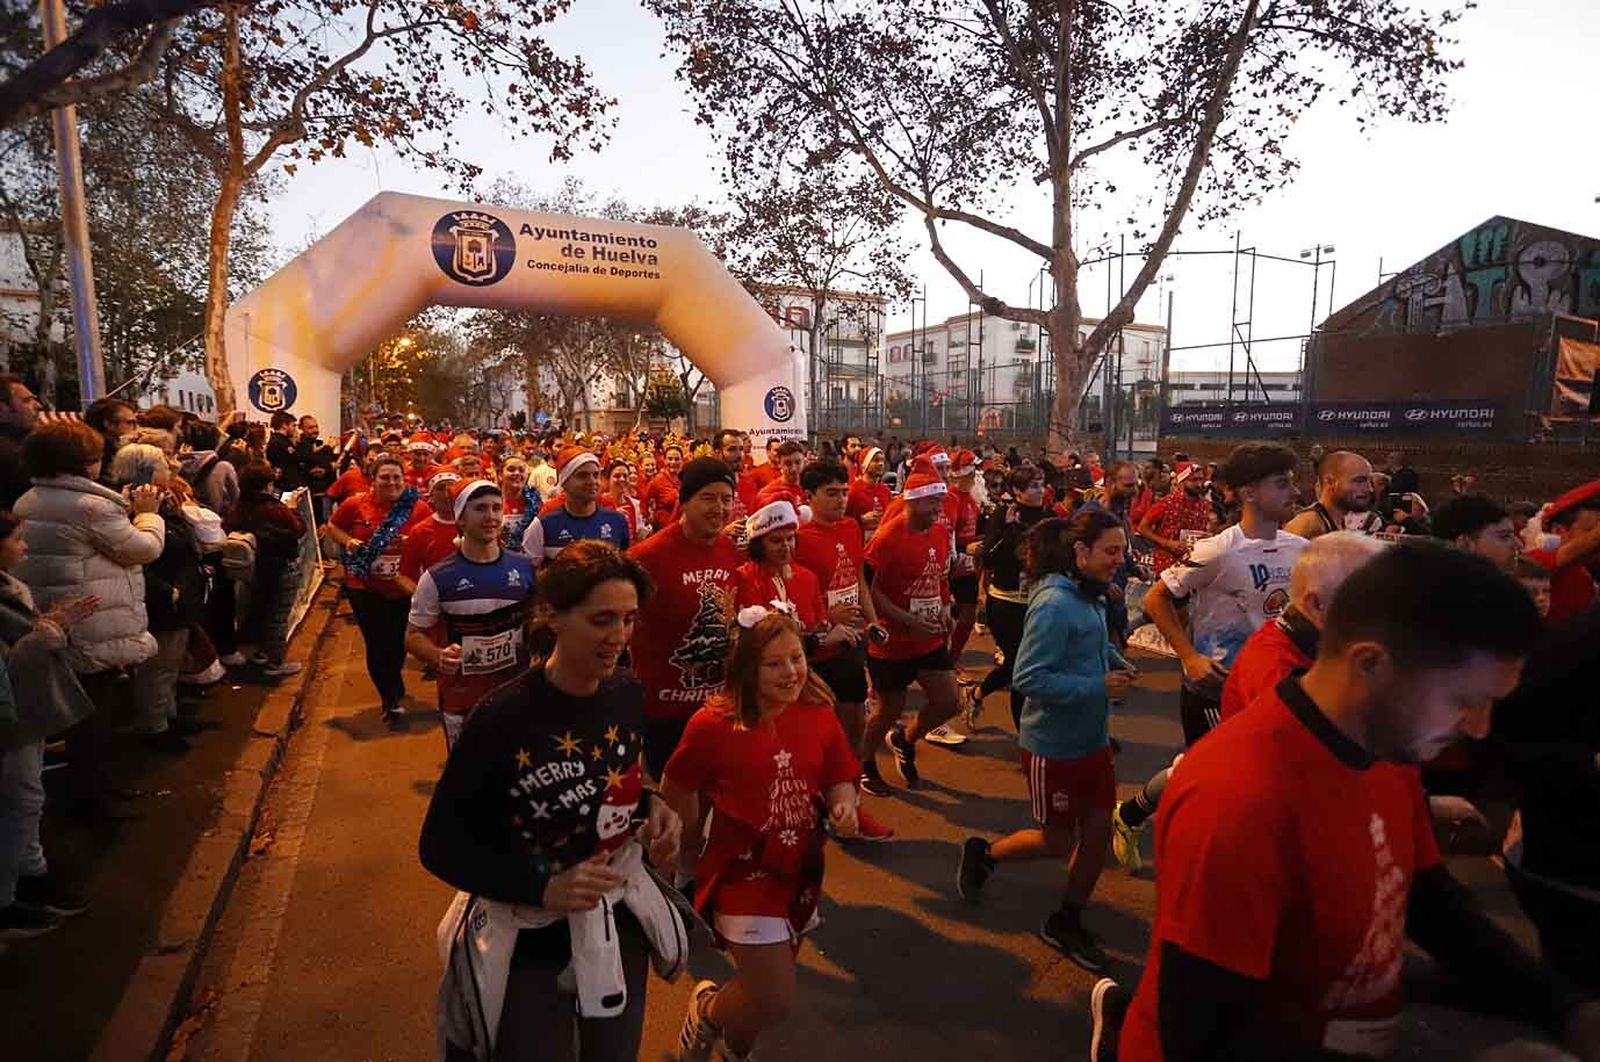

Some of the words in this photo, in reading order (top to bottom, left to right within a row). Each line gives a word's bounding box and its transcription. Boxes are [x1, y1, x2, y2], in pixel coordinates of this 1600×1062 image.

[519, 223, 658, 249] Ayuntamiento
[561, 244, 585, 259] de
[592, 248, 659, 266] Huelva
[592, 264, 607, 275] de
[610, 266, 661, 280] Deportes
[1186, 413, 1223, 421] HYUNDAI
[1250, 412, 1293, 420] HYUNDAI
[1338, 410, 1391, 420] HYUNDAI
[1430, 409, 1495, 419] HYUNDAI
[682, 568, 731, 585] MERRY
[486, 642, 511, 662] 570
[519, 760, 586, 793] MERRY
[530, 779, 598, 818] X-MAS
